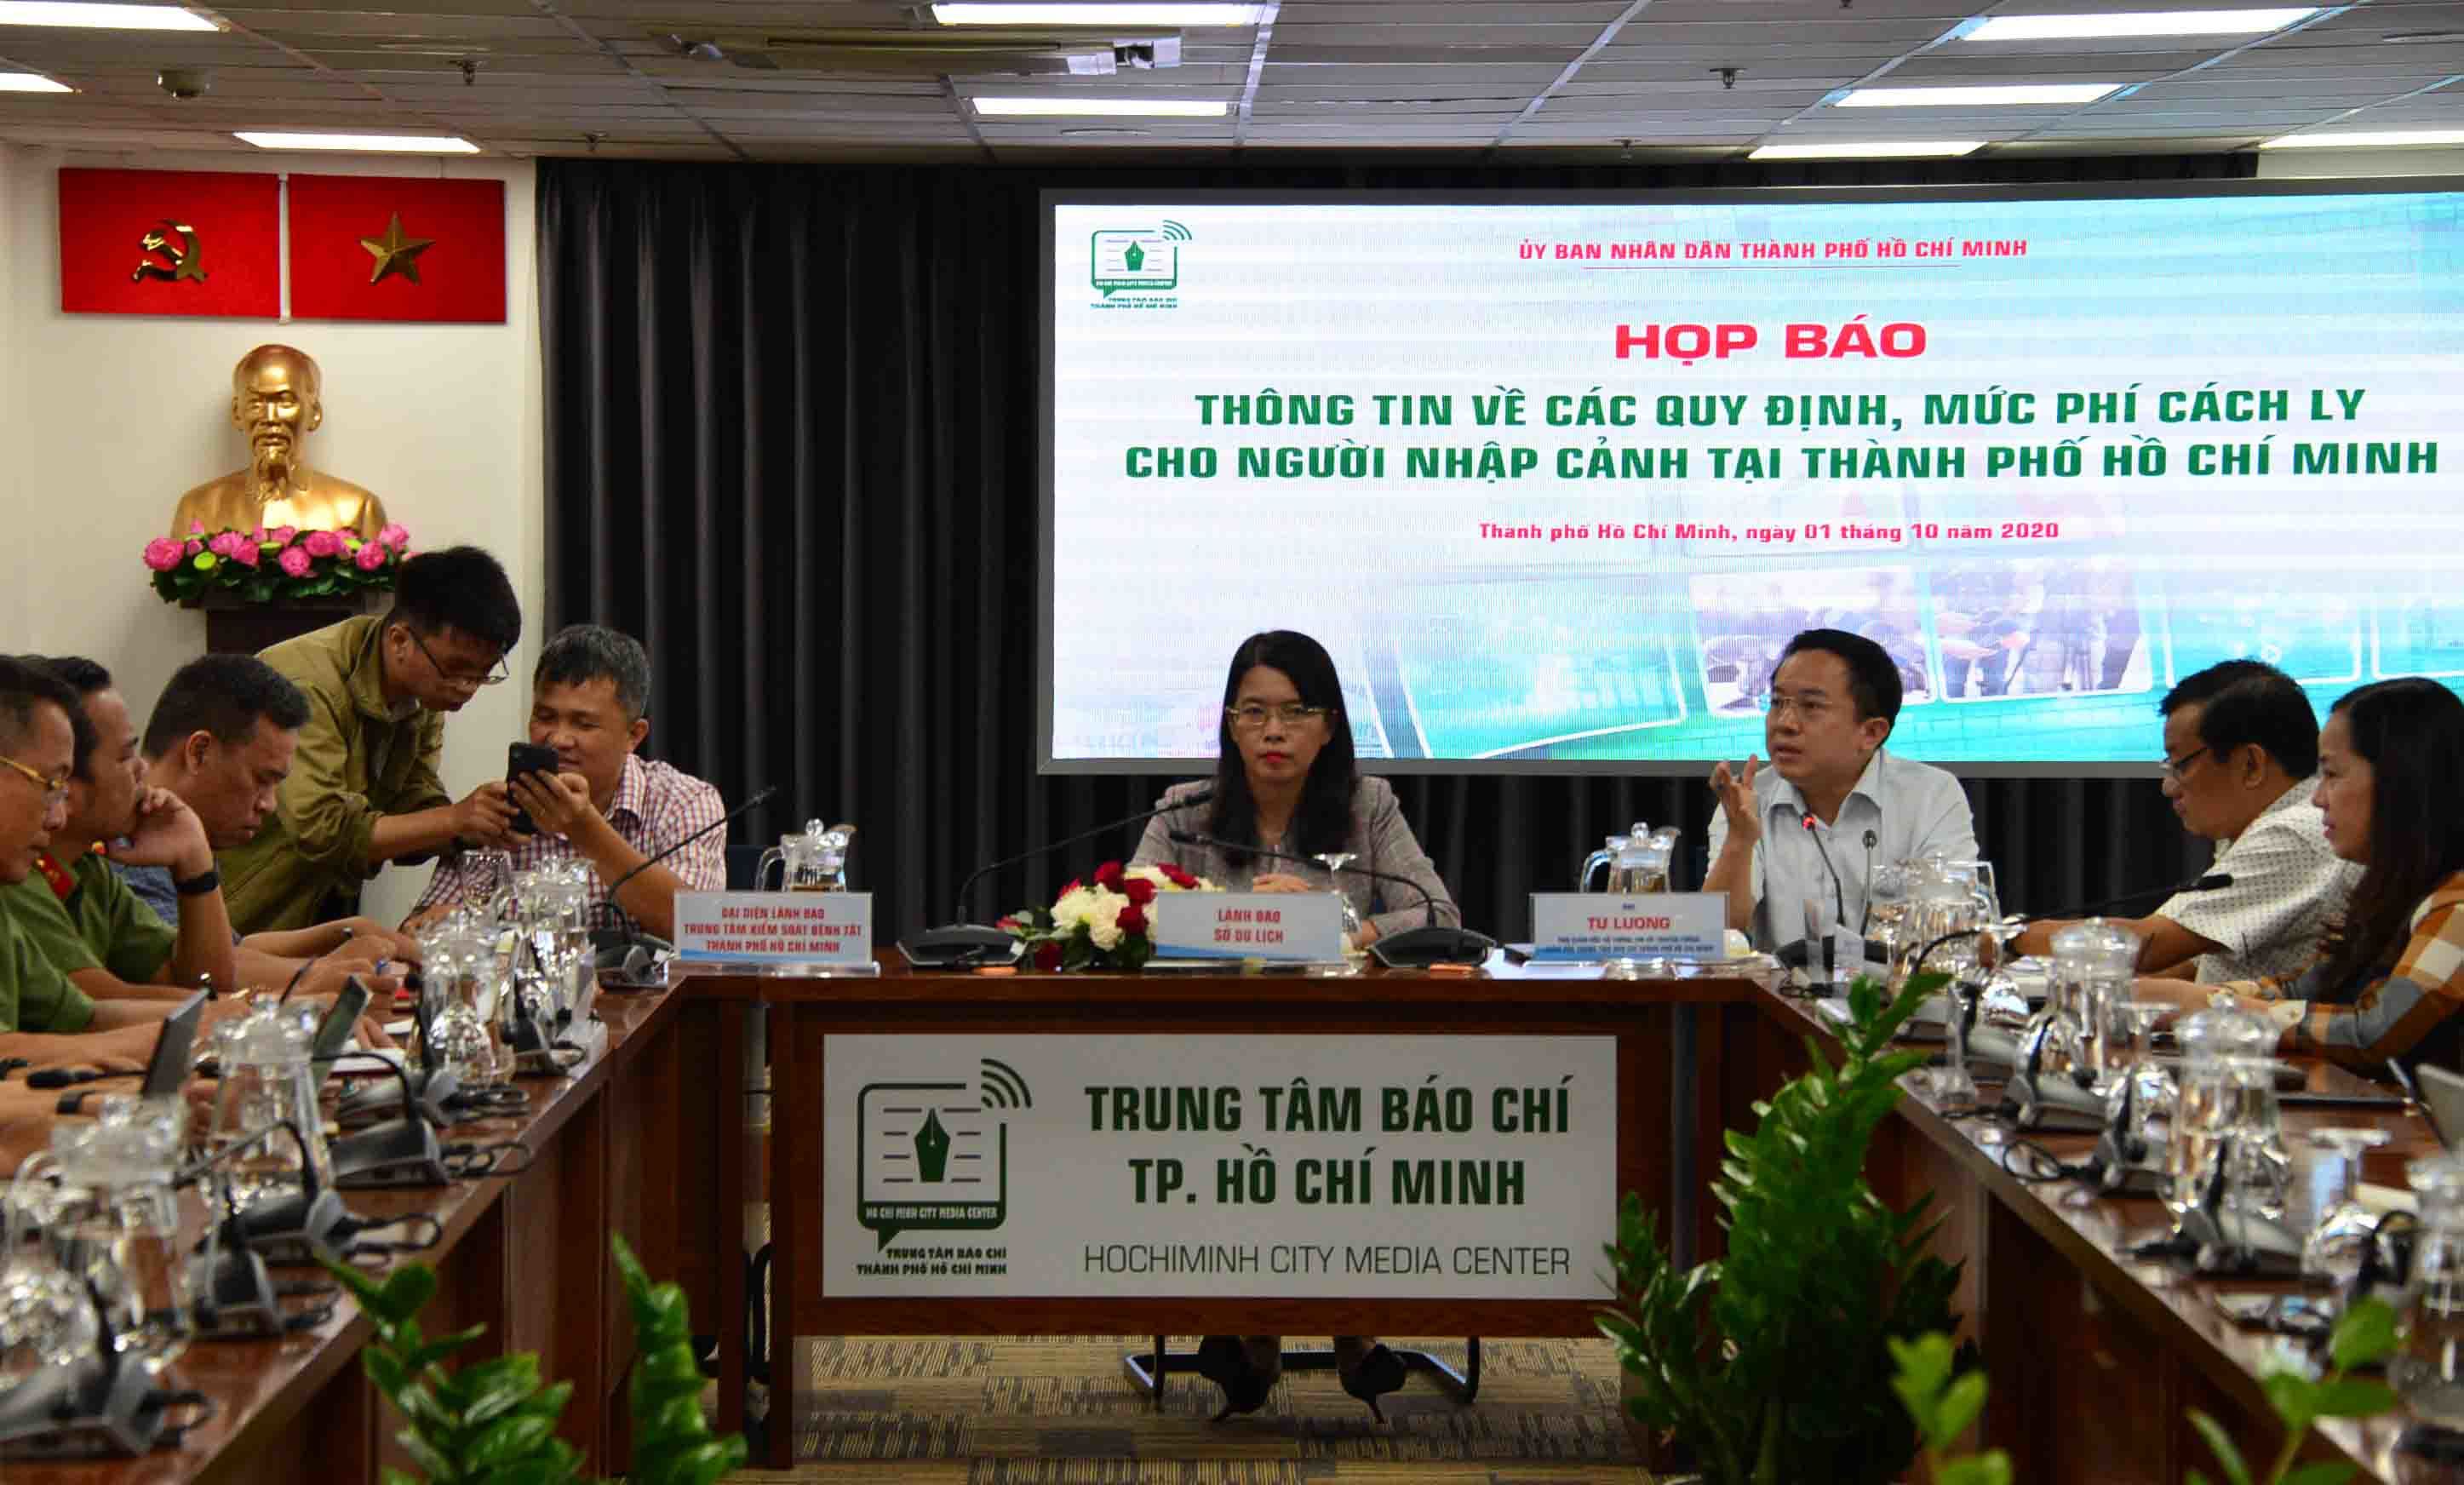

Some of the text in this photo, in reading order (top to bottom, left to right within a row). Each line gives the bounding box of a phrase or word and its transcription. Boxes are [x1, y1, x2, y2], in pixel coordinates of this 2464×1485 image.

[1519, 237, 2027, 260] ỦY BAN NHÂN DÂN THÀNH PHỐ HỒ CHÍ MINH
[1615, 313, 1927, 367] HỌP BÁO
[1195, 381, 2366, 432] THÔNG TIN VỀ CÁC QUY ĐỊNH, MỨC PHÍ CÁCH LY
[1126, 433, 2438, 483] CHO NGƯỜI NHẬP CẢNH TẠI THÀNH PHỐ HỒ CHÍ MINH
[1632, 524, 1669, 539] Chí
[1674, 522, 1739, 542] Minh,
[1745, 524, 1796, 543] ngày
[1804, 524, 1831, 539] 01
[1840, 523, 1902, 542] tháng
[1910, 523, 1940, 539] 10
[2001, 522, 2060, 539] 2020
[1084, 1074, 1574, 1133] TRUNG TÂM BÁO CHÍ
[1128, 1143, 1525, 1206] TP. HỒ CHÍ MINH
[939, 1207, 966, 1219] MEDIA
[967, 1207, 998, 1219] CENTER
[886, 1247, 925, 1259] TRUNG
[975, 1263, 1007, 1275] MINH
[1085, 1244, 1571, 1276] HOCHIMINH CITY MEDIA CENTER
